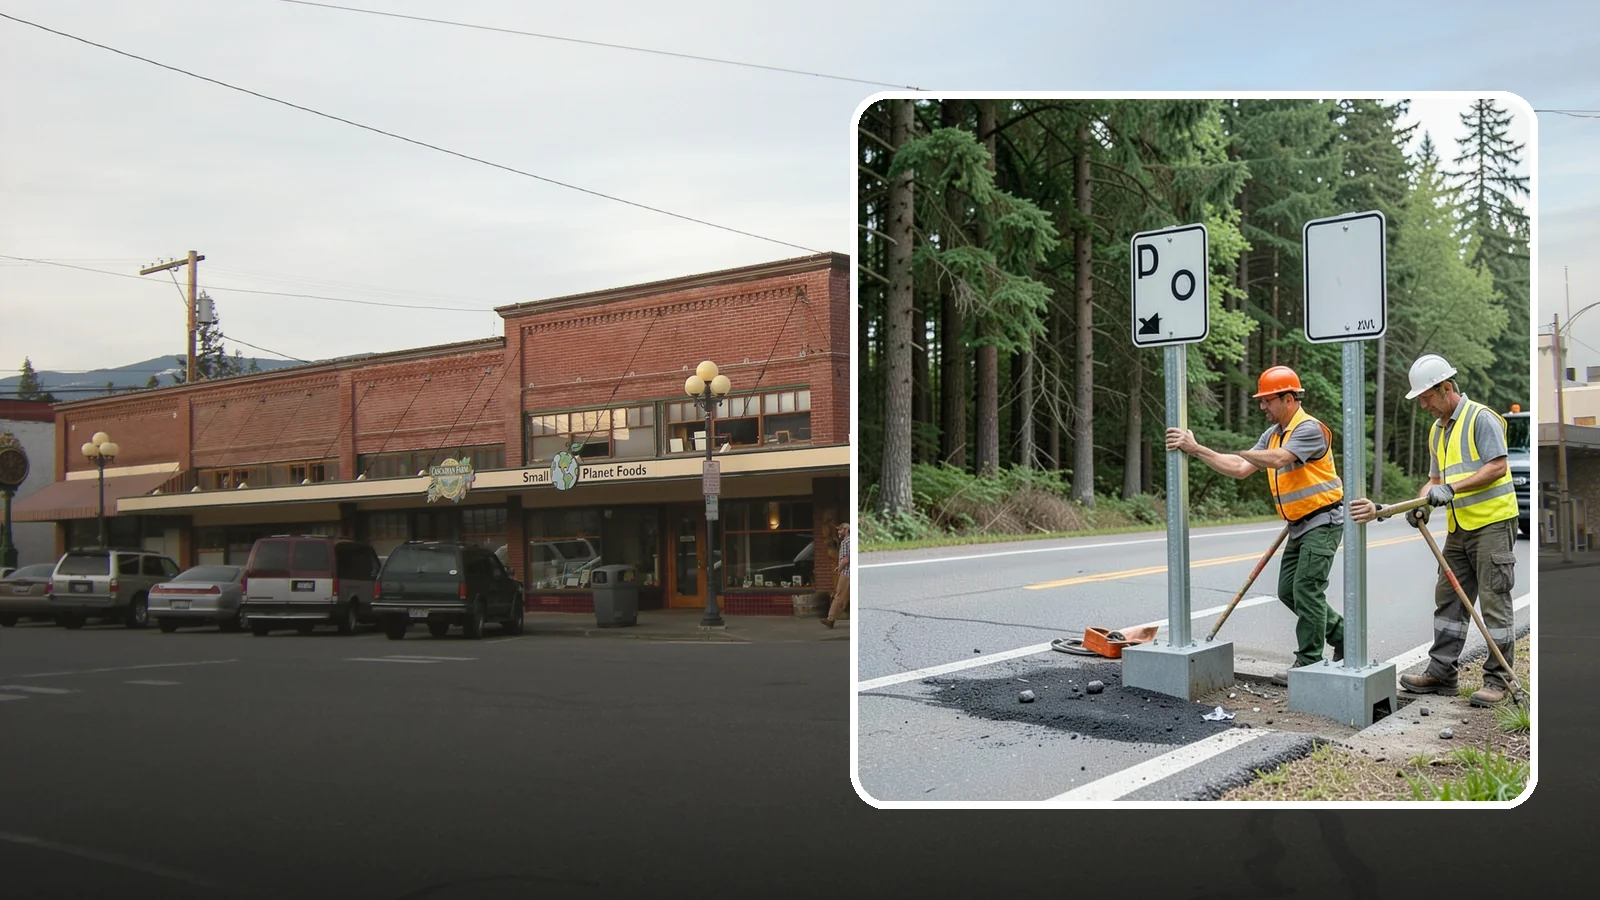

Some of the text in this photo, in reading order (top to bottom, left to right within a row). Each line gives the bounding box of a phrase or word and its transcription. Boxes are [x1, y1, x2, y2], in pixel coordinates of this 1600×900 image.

[1171, 269, 1196, 301] O
[523, 464, 647, 482] Small Planet Foods
